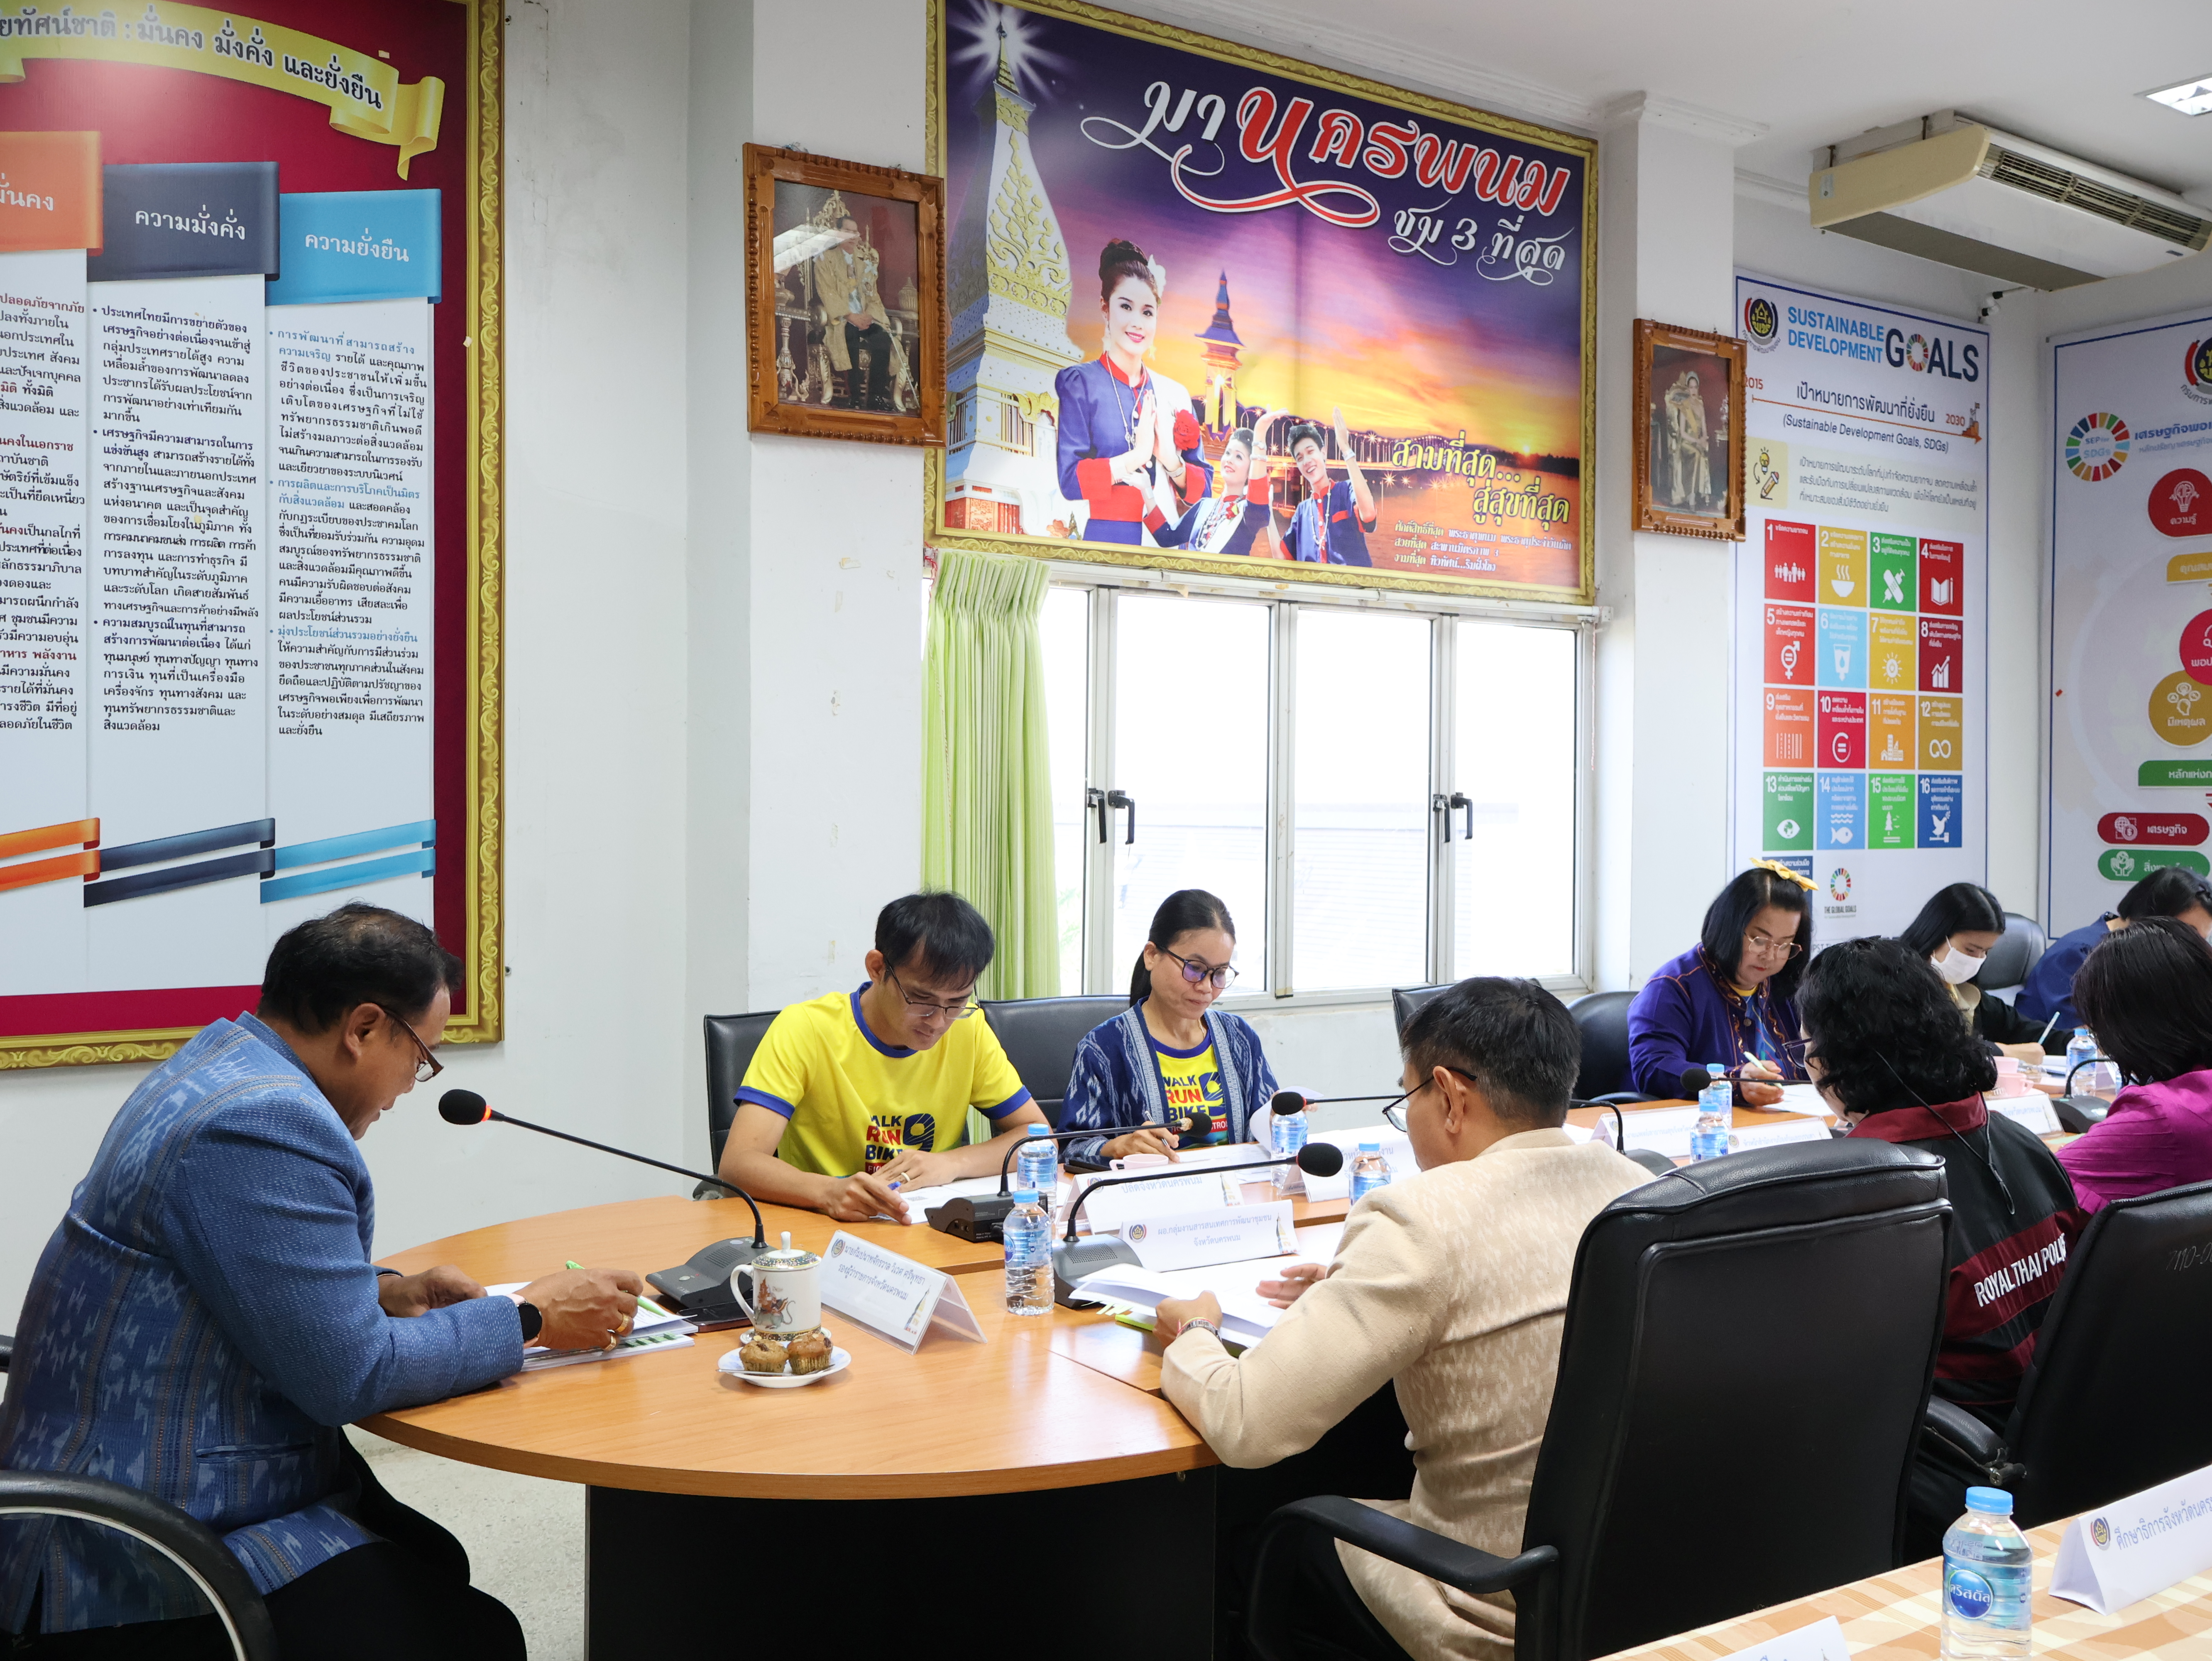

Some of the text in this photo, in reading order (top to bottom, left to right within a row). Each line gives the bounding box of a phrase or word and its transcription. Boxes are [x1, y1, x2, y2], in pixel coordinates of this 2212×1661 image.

[137, 5, 203, 49] มั่นคง
[215, 20, 274, 67] มั่งคั่ง
[284, 56, 382, 110] และยั่งยืน
[135, 204, 246, 240] ความมั่งคั่ง
[1451, 218, 1478, 251] 3
[305, 228, 409, 262] ความยั่งยืน
[1788, 306, 1884, 342] SUSTAINABLE
[103, 325, 250, 354] เศรษฐกิจอย่างต่อเนื่องจนเข้าสู่
[1788, 329, 1882, 363] DEVELOPMENT
[50, 351, 79, 365] สังคม
[103, 340, 244, 366] กลุ่มประเทศรายได้สูง ความ
[279, 347, 424, 372] ความเจริญ รายได้ และคุณภาพ
[1886, 328, 1979, 382] GOALS
[103, 355, 249, 383] เหลื่อมล้ำของการพัฒนาลดลง
[281, 361, 427, 388] ชีวิตของประชาชนให้เพิ่มขึ้น
[22, 380, 54, 397] ทั้งมิติ
[103, 375, 252, 400] ประชากรได้รับผลประโยชน์จาก
[280, 379, 424, 405] อย่างต่อเนื่อง ซึ่งเป็นการเจริญ
[103, 393, 242, 416] การพัฒนาอย่างเท่าเทียมกัน
[281, 394, 423, 420] เติบโตของเศรษฐกิจที่ไม่ใช้
[1797, 381, 1935, 423] เป้าหมายการพัฒนาที่ยั่งยืน
[60, 407, 79, 416] และ
[103, 407, 140, 422] มากขึ้น
[1945, 414, 1965, 426] 2030
[281, 412, 422, 436] ทรัพยากรธรรมชาติเกินพอดี
[1783, 413, 1948, 453] (Sustainable Development Goals, SDGs)
[103, 429, 253, 451] เศรษฐกิจมีความสามารถในการ
[280, 425, 423, 451] ไม่สร้างมลภาวะต่อสิ่งแวดล้อม
[104, 443, 254, 467] แข่งขันสูง สามารถสร้างรายได้ทั้ง
[279, 445, 422, 467] จนเกินความสามารถในการรองรับ
[104, 462, 256, 484] จากภายในและภายนอกประเทศ
[279, 462, 403, 481] และเยียวยาของระบบนิเวศน์
[104, 478, 245, 499] สร้างฐานเศรษฐกิจและสังคม
[278, 479, 420, 499] การผลิตและการบริโภคเป็นมิตร
[104, 495, 248, 518] แห่งอนาคต และเป็นจุดสำคัญ
[279, 490, 410, 514] กับสิ่งแวดล้อม และสอดคล้อง
[104, 512, 252, 534] ของการเชื่อมโยงในภูมิภาค ทั้ง
[279, 510, 418, 531] กับกฎระเบียบของประชาคมโลก
[104, 532, 256, 550] การคมนาคมขนส่ง การผลิต การค้า
[279, 523, 424, 550] ซึ่งเป็นที่ยอมรับร่วมกัน ความอุดม
[1767, 524, 1773, 541] 1
[1821, 530, 1829, 547] 2
[279, 544, 421, 563] สมบูรณ์ของทรัพยากรธรรมชาติ
[1431, 541, 1490, 556] สะพานมิตรภาพ
[1872, 537, 1880, 553] 3
[1921, 543, 1928, 559] 4
[104, 549, 247, 568] การลงทุน และการทำธุรกิจ มี
[279, 557, 412, 578] และสิ่งแวดล้อมมีคุณภาพดีขึ้น
[104, 566, 247, 585] บทบาทสำคัญในระดับภูมิภาค
[104, 583, 249, 600] และระดับโลก เกิดสายสัมพันธ์
[279, 576, 411, 594] คนมีความรับผิดชอบต่อสังคม
[104, 601, 258, 617] ทางเศรษฐกิจและการค้าอย่างมีพลัง
[279, 590, 407, 610] มีความเอื้ออาทร เสียสละเพื่อ
[12, 613, 77, 627] ชุมชนมีความ
[103, 617, 245, 634] ความสมบูรณ์ในทุนที่สามารถ
[279, 609, 372, 624] ผลประโยชน์ส่วนรวม
[1767, 608, 1775, 625] 5
[1820, 612, 1828, 629] 6
[1872, 617, 1879, 632] 7
[278, 625, 418, 642] มุ่งประโยชน์ส่วนรวมอย่างยั่งยืน
[1921, 621, 1928, 637] 8
[104, 633, 250, 650] สร้างการพัฒนาต่อเนื่อง ได้แก่
[278, 640, 418, 659] ให้ความสำคัญกับการมีส่วนร่วม
[33, 648, 76, 660] พลังงาน
[104, 652, 258, 670] ทุนมนุษย์ ทุนทางปัญญา ทุนทาง
[104, 666, 245, 684] การเงิน ทุนที่เป็นเครื่องมือ
[279, 659, 423, 674] ของประชาชนทุกภาคส่วนในสังคม
[104, 681, 246, 701] เครื่องจักร ทุนทางสังคม และ
[279, 674, 421, 691] ยึดถือและปฏิบัติตามปรัชญาของ
[46, 697, 77, 716] มีที่อยู่
[279, 691, 423, 706] เศรษฐกิจพอเพียงเพื่อการพัฒนา
[1766, 693, 1775, 710] 9
[1820, 696, 1831, 713] 10
[1872, 699, 1881, 715] 11
[104, 703, 235, 716] ทุนทรัพยากรธรรมชาติและ
[278, 706, 424, 724] ในระดับอย่างสมดุล มีเสถียรภาพ
[1921, 701, 1930, 717] 12
[104, 714, 159, 731] สิ่งแวดล้อม
[279, 720, 322, 735] และยั่งยืน
[1766, 775, 1776, 793] 13
[1820, 777, 1830, 793] 14
[1871, 777, 1881, 794] 15
[1920, 778, 1930, 794] 16
[2147, 824, 2187, 836] เศรษฐกิจ
[1158, 1214, 1272, 1236] ผอ.กลุ่มงานสารสนเทศการพัฒนาชุมชน
[1194, 1234, 1241, 1246] จังหวัดนครพนม
[1974, 1252, 2042, 1307] ROYAL THAI
